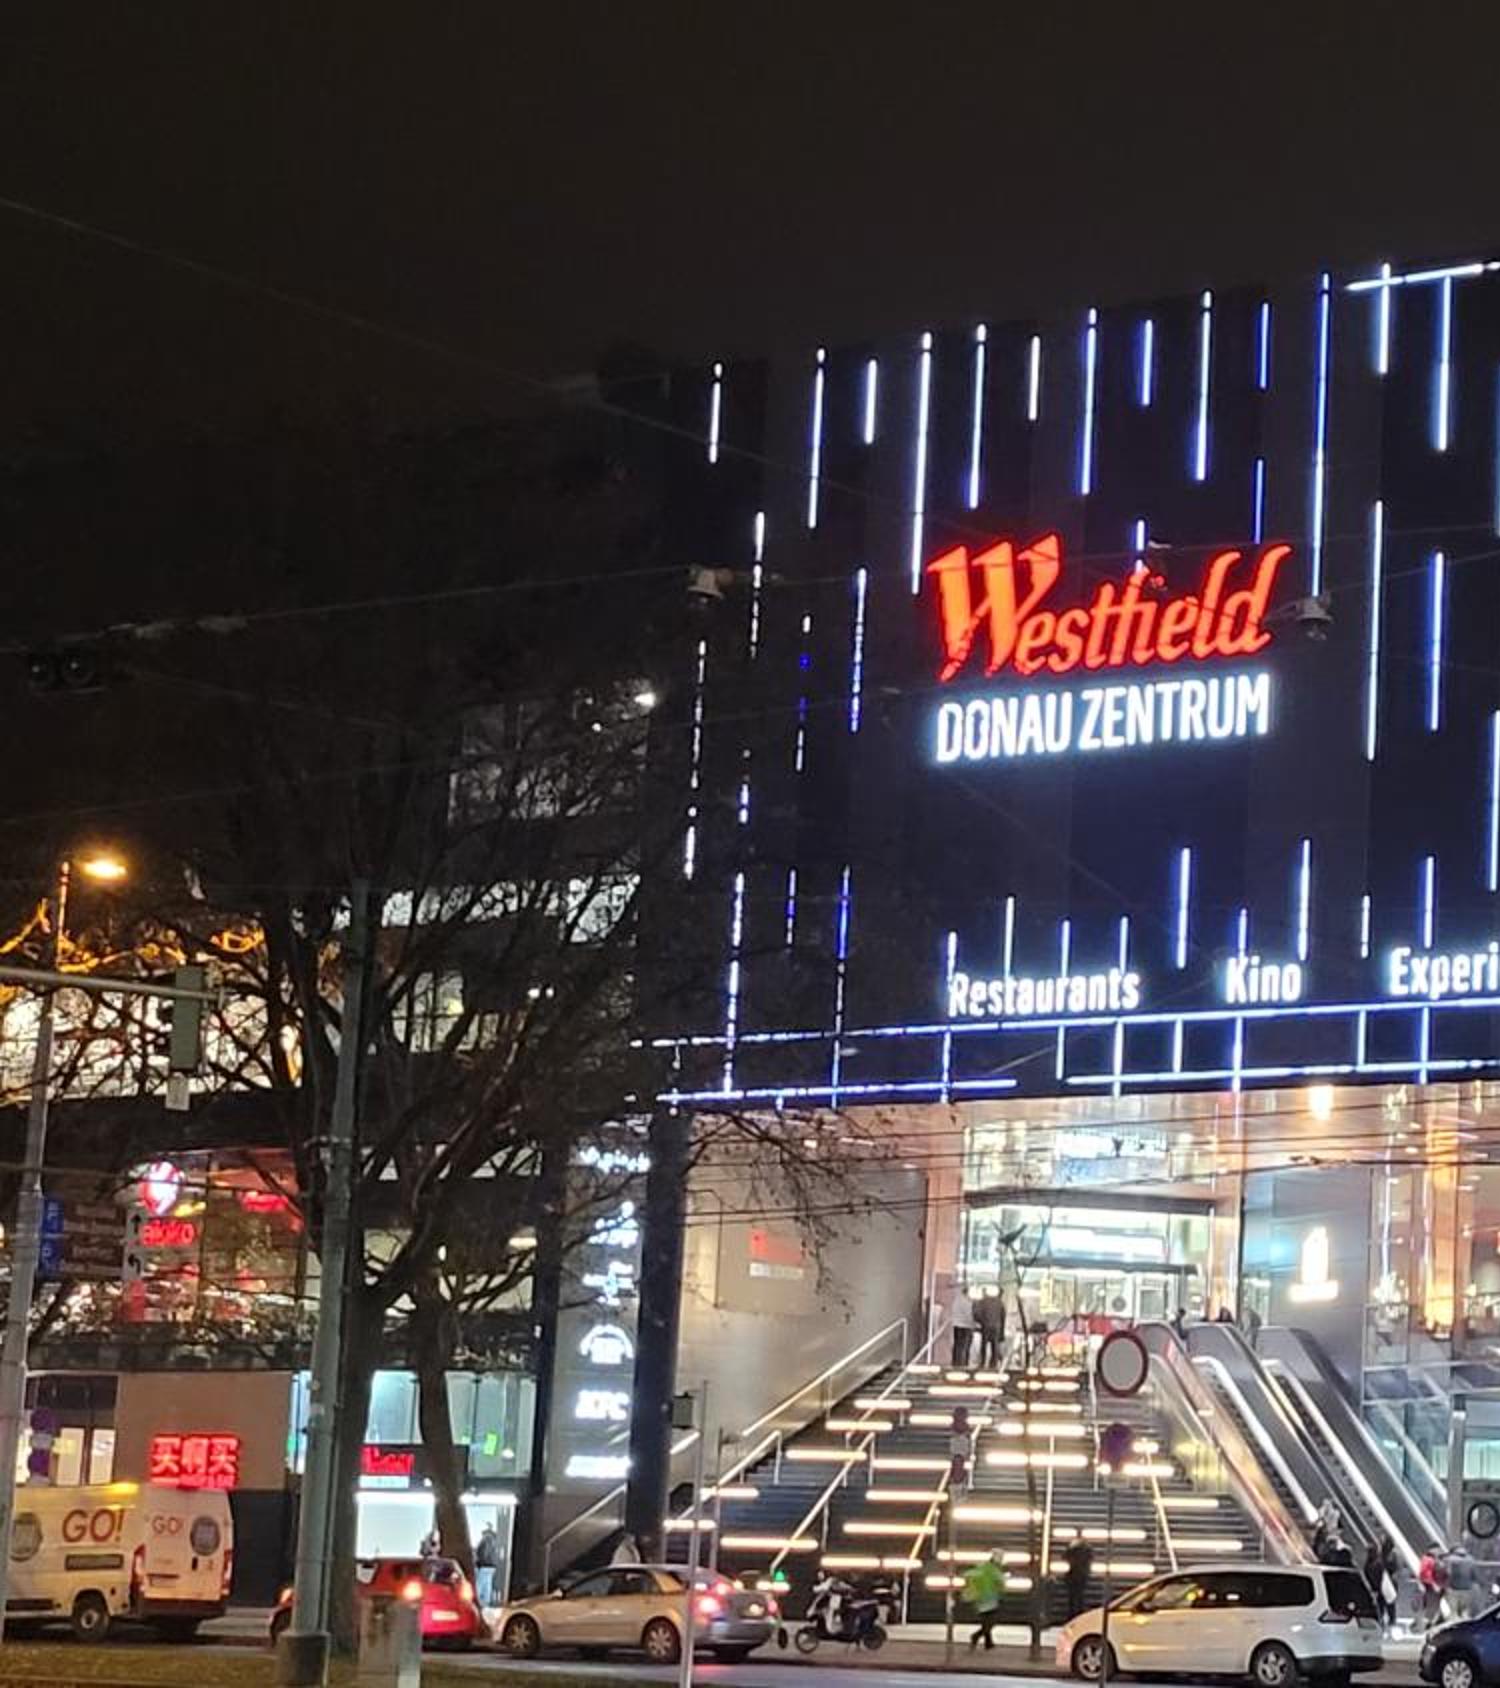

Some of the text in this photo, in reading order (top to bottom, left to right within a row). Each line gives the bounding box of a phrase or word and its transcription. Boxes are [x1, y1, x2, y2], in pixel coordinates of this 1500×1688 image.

[927, 535, 1291, 682] Westfield
[936, 673, 1270, 763] DONAU ZENTRUM
[949, 967, 1141, 1017] Restaurants
[1226, 955, 1302, 1004] Kino
[62, 1508, 125, 1543] GO!
